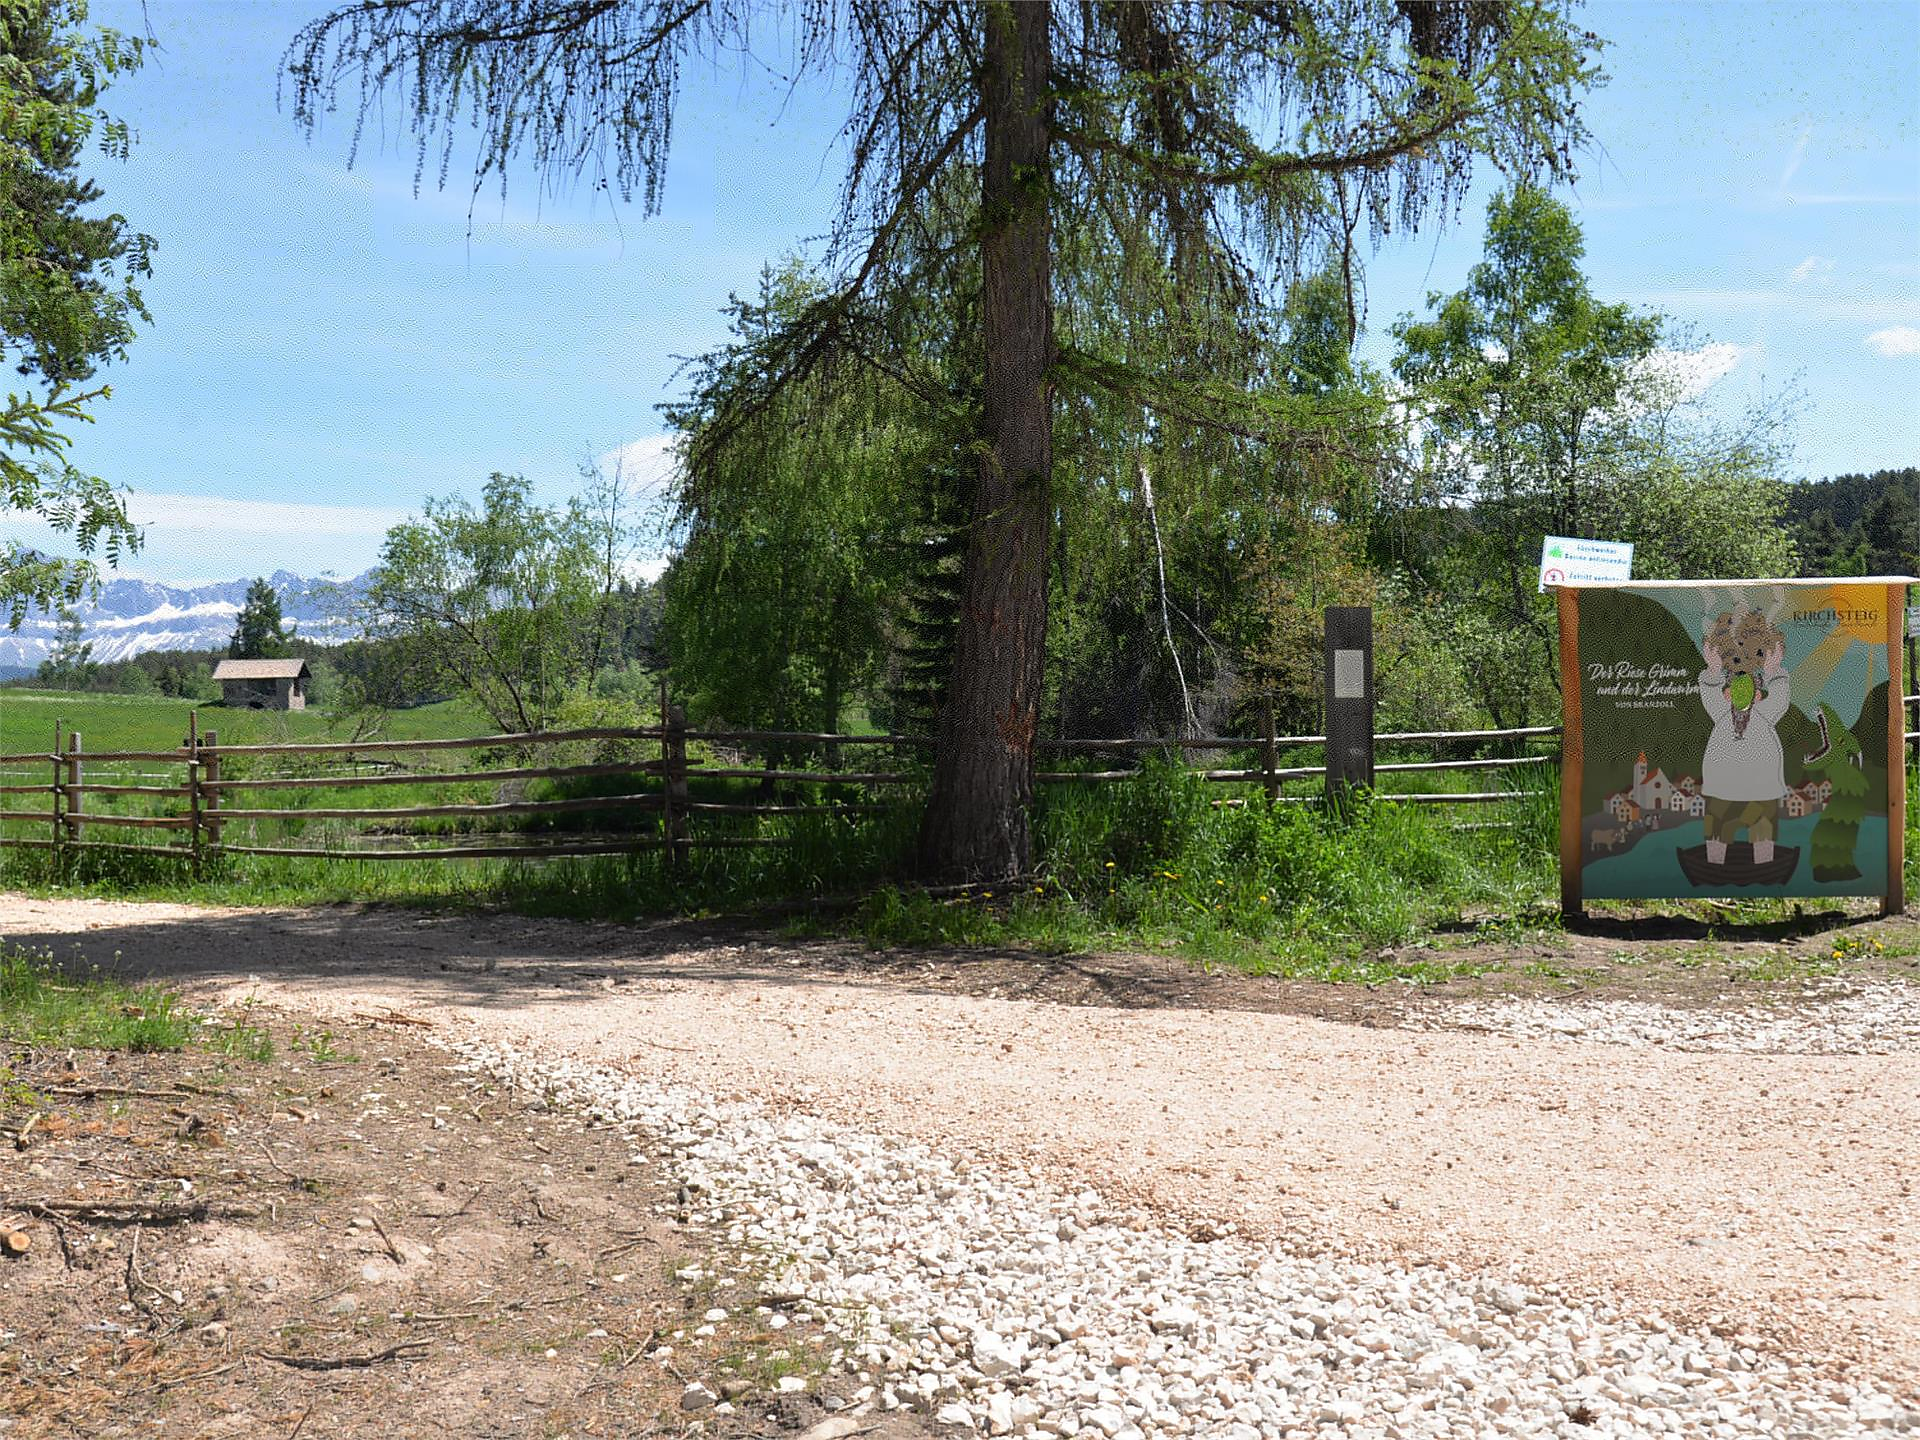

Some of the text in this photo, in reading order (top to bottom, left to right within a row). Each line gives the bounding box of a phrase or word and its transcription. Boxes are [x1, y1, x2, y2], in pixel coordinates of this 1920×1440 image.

[1793, 609, 1878, 621] KIRCHSTEIG
[1588, 662, 1613, 680] Der
[1621, 682, 1640, 696] der
